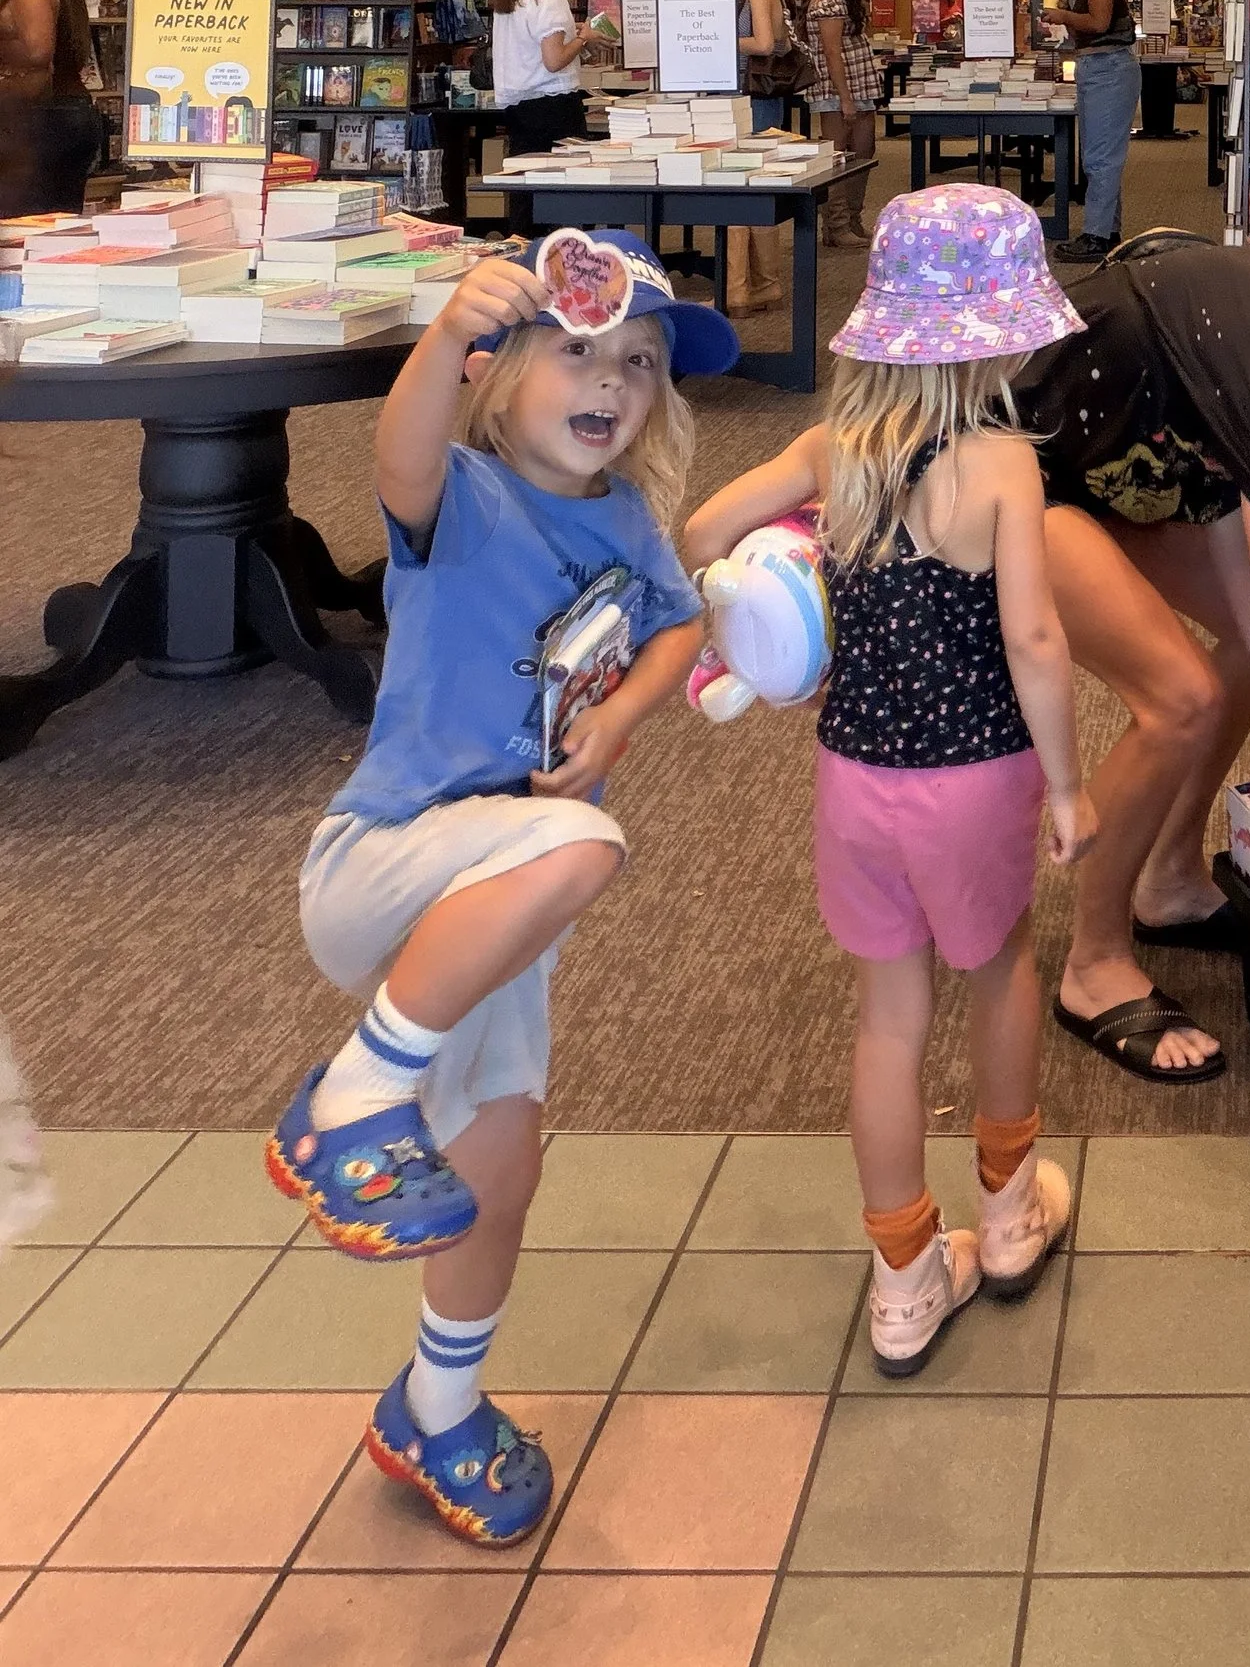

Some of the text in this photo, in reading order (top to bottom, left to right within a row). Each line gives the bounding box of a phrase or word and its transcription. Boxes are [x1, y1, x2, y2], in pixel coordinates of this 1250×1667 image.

[679, 10, 716, 18] The Best
[155, 14, 250, 31] PAPERBACK
[692, 21, 704, 30] Of
[158, 35, 242, 44] YOUR FAVORITES ARE
[676, 32, 720, 43] Paperback
[202, 46, 222, 54] HERE
[683, 44, 713, 54] Fiction
[338, 124, 364, 134] LOVE
